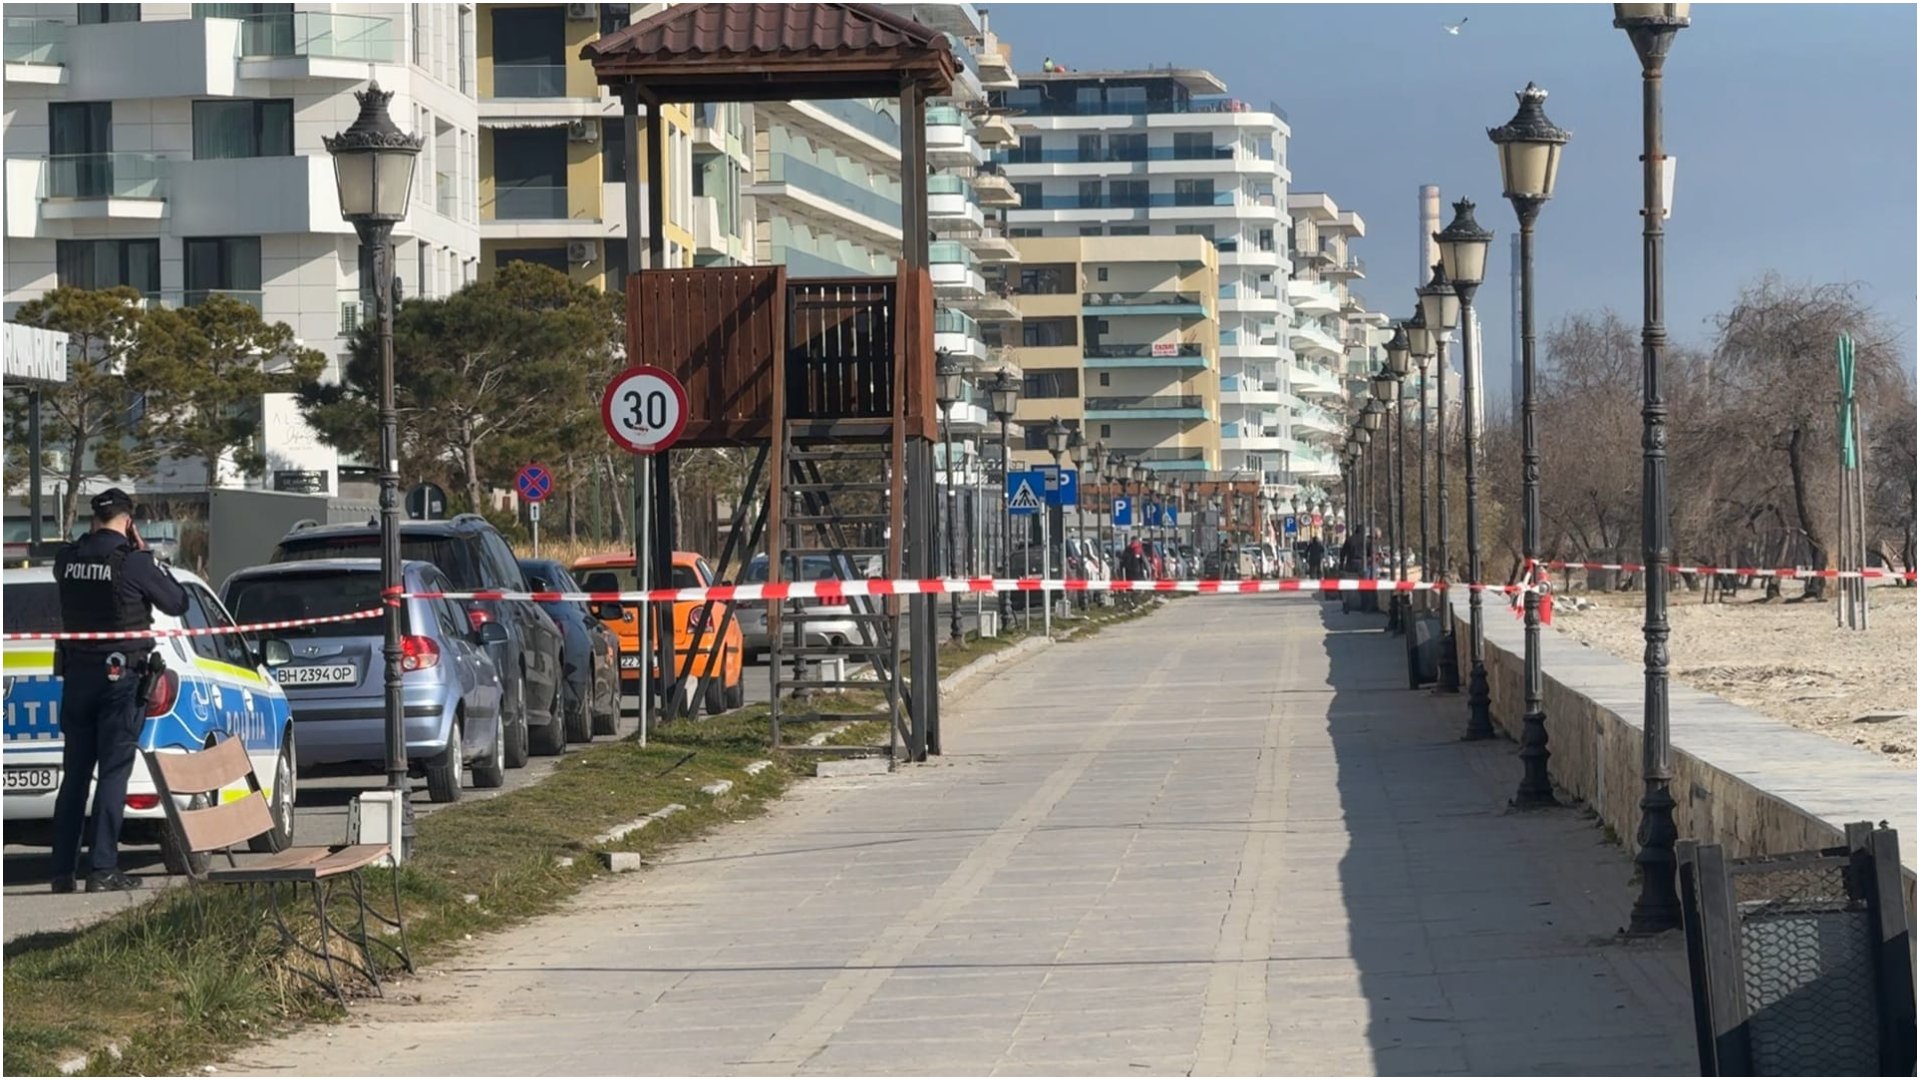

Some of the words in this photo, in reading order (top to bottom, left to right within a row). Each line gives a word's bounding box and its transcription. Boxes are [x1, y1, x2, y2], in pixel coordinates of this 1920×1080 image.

[623, 390, 666, 430] 30
[1115, 500, 1126, 517] P
[1286, 517, 1294, 528] P
[64, 562, 112, 581] POLITIA
[277, 669, 298, 683] BH
[300, 667, 330, 682] 2394
[332, 666, 352, 680] OP
